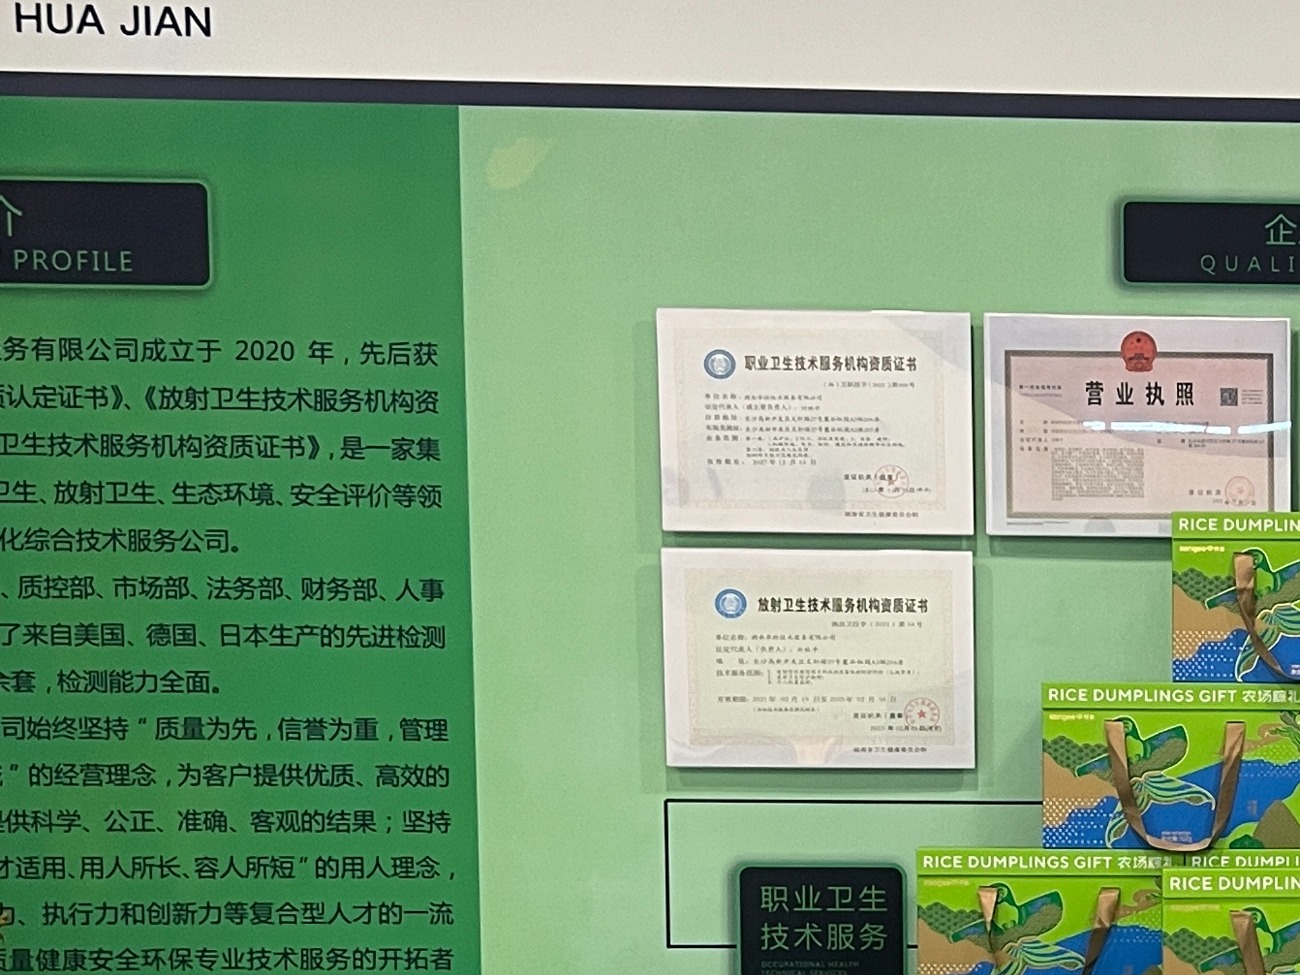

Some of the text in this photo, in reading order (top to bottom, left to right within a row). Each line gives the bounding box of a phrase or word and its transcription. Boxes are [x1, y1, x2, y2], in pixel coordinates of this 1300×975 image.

[14, 3, 213, 37] HUA JIAN
[14, 249, 133, 272] PROFILE
[0, 336, 222, 363] 务有限公司成立于
[235, 340, 295, 362] 2020
[744, 355, 917, 372] 职业卫生技术服务机构资质证书
[0, 384, 439, 414] 认定证书》、《放射卫生技术服务机构资
[1085, 380, 1194, 406] 营业执照
[1178, 517, 1218, 531] RICE
[757, 597, 929, 613] 放射卫生技术服务机构资质证书
[1048, 688, 1237, 703] RICE DUMPLINGS GIFT
[0, 809, 451, 834] 供科学、公正、准确、客观的结果；坚持
[1169, 876, 1213, 891] RICE
[760, 884, 888, 913] 职业卫生
[760, 922, 888, 951] 技术服务
[0, 947, 454, 971] 量健康安全环保专业技术服务的开拓者
